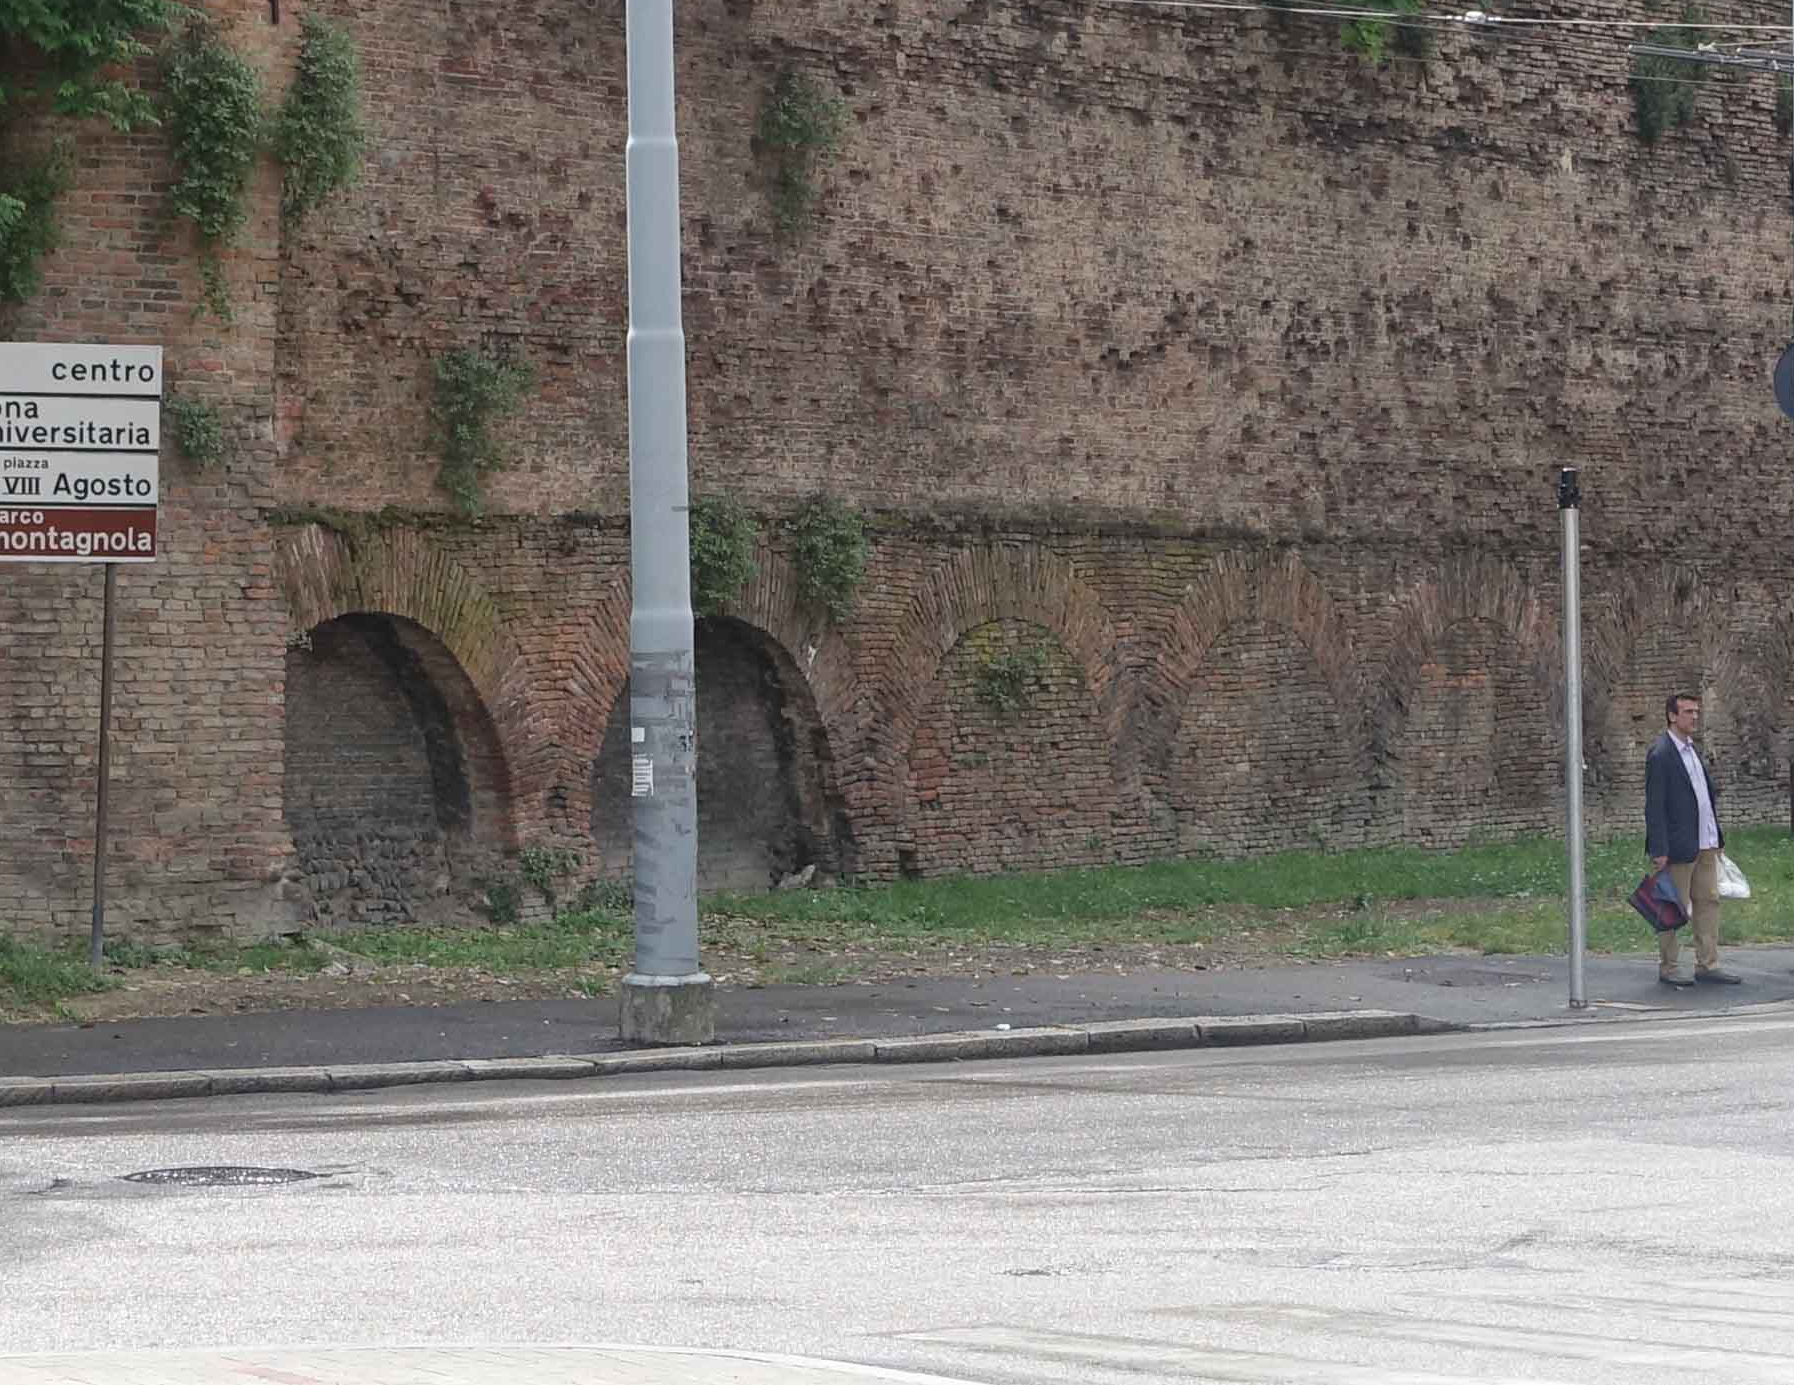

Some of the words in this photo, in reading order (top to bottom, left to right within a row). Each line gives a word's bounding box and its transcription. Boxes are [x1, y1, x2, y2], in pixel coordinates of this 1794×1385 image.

[52, 359, 155, 383] centro
[3, 457, 49, 471] piazza
[3, 477, 41, 496] VIII
[53, 473, 151, 500] Agosto
